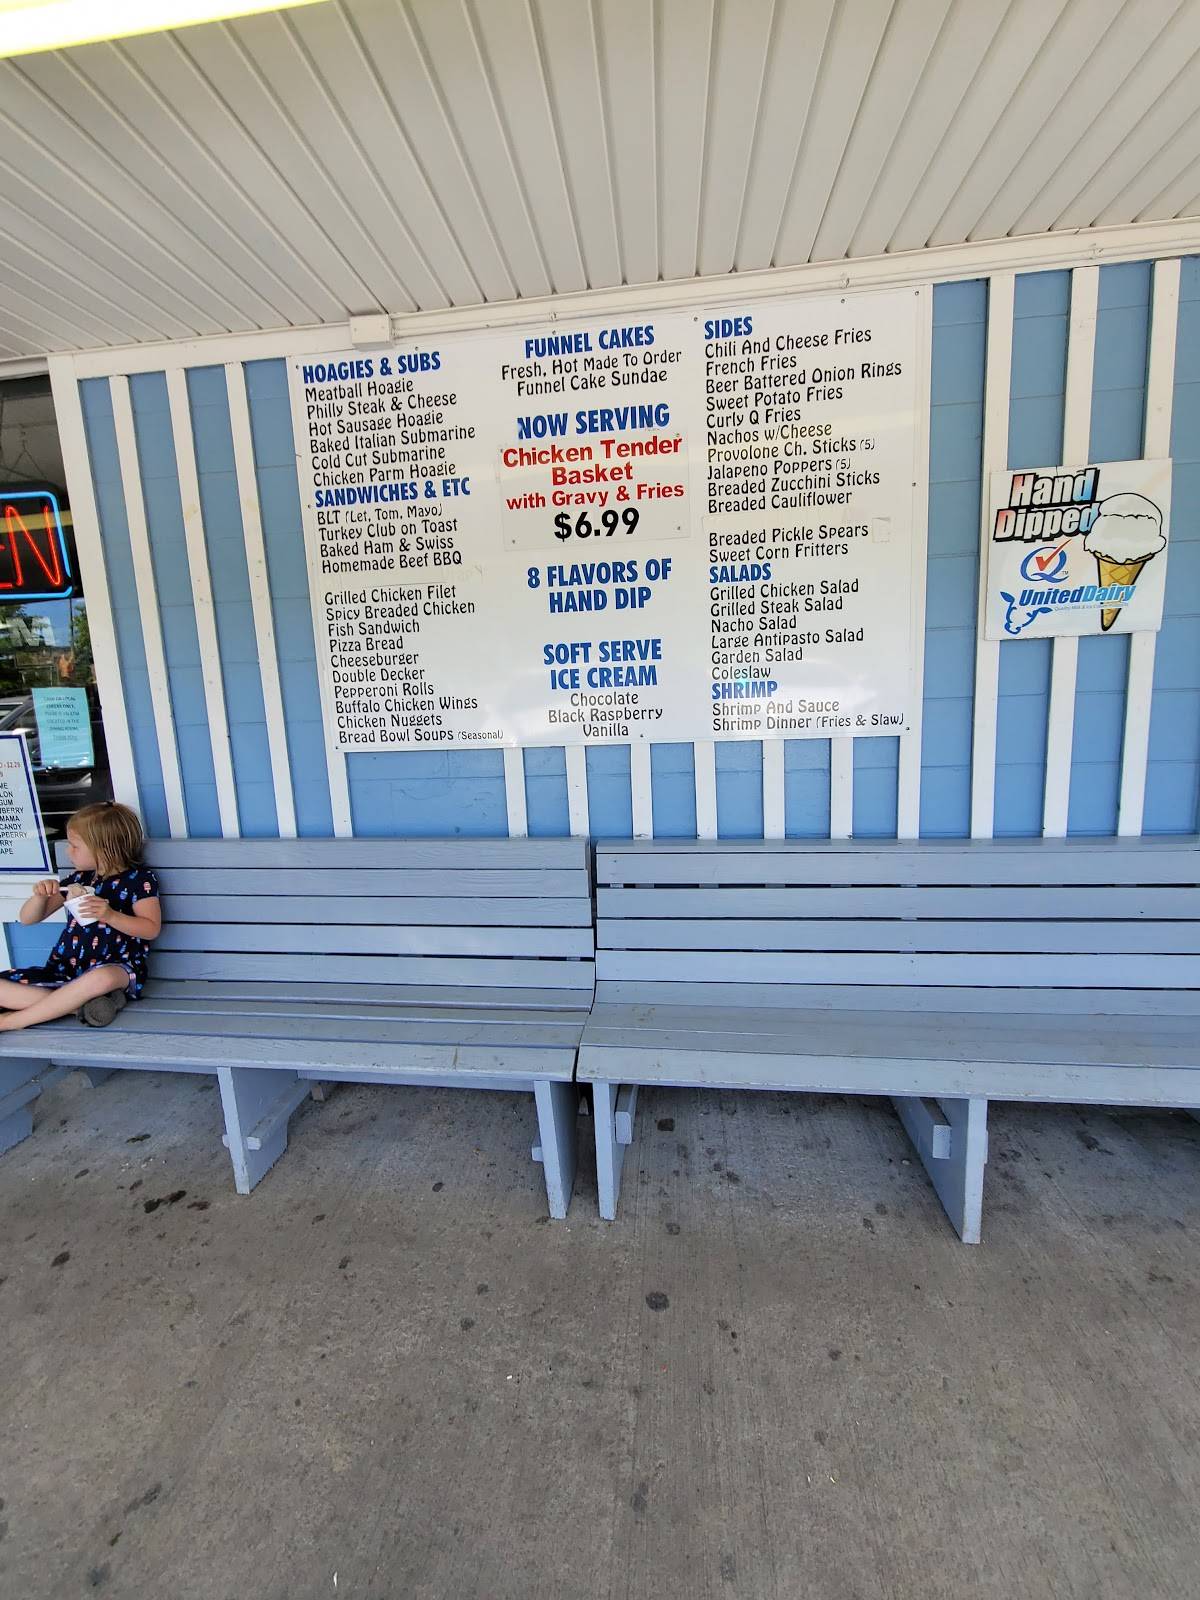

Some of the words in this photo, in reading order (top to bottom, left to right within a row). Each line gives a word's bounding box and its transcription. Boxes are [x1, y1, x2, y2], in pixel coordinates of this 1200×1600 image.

[705, 316, 752, 340] SIDES
[525, 333, 592, 359] FUNNEL
[598, 325, 654, 350] CAKES
[705, 341, 736, 358] Chili
[742, 338, 770, 355] And
[776, 334, 829, 350] Cheese
[834, 328, 872, 345] Fries
[302, 360, 373, 383] HOAGIES
[380, 358, 392, 376] &
[398, 351, 441, 374] SUBS
[501, 362, 546, 380] Fresh,
[552, 359, 578, 375] Hot
[584, 355, 618, 371] Made
[623, 353, 638, 366] To
[643, 350, 682, 365] Order
[706, 359, 754, 376] French
[761, 355, 797, 371] Fries
[517, 377, 565, 396] Funnel
[570, 374, 606, 390] Cake
[611, 368, 668, 386] Sundae
[706, 379, 738, 394] Beer
[744, 370, 806, 390] Battered
[812, 367, 855, 382] Onion
[861, 362, 902, 379] Rings
[305, 382, 362, 402] Meatball
[367, 378, 414, 396] Hoagie
[706, 395, 749, 411] Sweet
[754, 391, 801, 407] Potato
[806, 386, 843, 402] Fries
[307, 404, 343, 419] Philly
[348, 401, 385, 415] Steak
[390, 397, 402, 411] &
[408, 392, 457, 409] Cheese
[309, 422, 332, 436] Hot
[337, 417, 392, 434] Sausage
[397, 410, 443, 428] Hoagie
[517, 413, 568, 439] NOW
[576, 403, 670, 434] SERVING
[706, 412, 744, 428] Curly
[750, 410, 759, 424] Q
[765, 408, 801, 423] Fries
[310, 437, 350, 453] Baked
[355, 434, 396, 449] Italian
[401, 425, 476, 445] Submarine
[707, 430, 759, 445] Nachos
[764, 424, 832, 440] w/Cheese
[312, 455, 341, 470] Cold
[345, 454, 368, 467] Cut
[372, 446, 446, 465] Submarine
[503, 445, 593, 467] Chicken
[600, 436, 682, 459] Tender
[708, 445, 779, 463] Provolone
[784, 442, 807, 456] Ch.
[813, 438, 857, 454] Sticks
[313, 472, 364, 486] Chicken
[369, 468, 404, 482] Parm
[410, 463, 456, 478] Hoagie
[552, 462, 633, 486] Basket
[708, 464, 768, 480] Jalapeno
[774, 459, 833, 475] Poppers
[315, 482, 418, 508] SANDWICHES
[424, 481, 437, 498] &
[442, 477, 471, 496] ETC
[708, 479, 766, 496] Breaded
[771, 475, 831, 492] Zucchini
[836, 470, 880, 487] Sticks
[1009, 468, 1100, 508] Hand
[506, 493, 545, 509] with
[552, 490, 608, 507] Gravy
[616, 485, 630, 501] &
[636, 483, 685, 500] Fries
[708, 496, 766, 513] Breaded
[771, 490, 852, 508] Cauliflower
[318, 510, 340, 525] BLT
[375, 508, 402, 520] Tom,
[407, 504, 442, 518] Mayo)
[554, 508, 639, 542] $6.99
[993, 501, 1101, 542] Dipped
[319, 527, 362, 541] Turkey
[368, 520, 395, 538] Club
[401, 524, 417, 535] on
[422, 518, 458, 533] Toast
[709, 530, 766, 547] Breaded
[772, 527, 814, 542] Pickle
[819, 525, 869, 539] Spears
[320, 542, 359, 558] Baked
[364, 541, 393, 554] Ham
[399, 538, 411, 551] &
[416, 536, 454, 550] Swiss
[709, 549, 751, 563] Sweet
[756, 547, 789, 560] Corn
[795, 543, 848, 558] Fritters
[322, 556, 395, 573] Homemade
[400, 554, 428, 568] Beef
[434, 551, 462, 565] BBQ
[527, 567, 540, 588] 8
[547, 560, 638, 587] FLAVORS
[646, 558, 672, 581] OF
[710, 563, 772, 584] SALADS
[324, 590, 367, 605] Grilled
[371, 587, 422, 603] Chicken
[428, 584, 456, 599] Filet
[550, 590, 607, 613] HAND
[615, 587, 651, 609] DIP
[710, 585, 755, 600] Grilled
[761, 583, 814, 598] Chicken
[820, 578, 859, 594] Salad
[326, 608, 360, 621] Spicy
[365, 604, 418, 619] Breaded
[423, 601, 475, 615] Chicken
[710, 602, 755, 617] Grilled
[761, 599, 799, 614] Steak
[805, 596, 843, 611] Salad
[328, 623, 354, 636] Fish
[358, 620, 420, 635] Sandwich
[711, 618, 754, 632] Nacho
[759, 615, 797, 630] Salad
[329, 639, 361, 652] Pizza
[366, 636, 403, 651] Bread
[712, 634, 749, 649] Large
[754, 631, 820, 647] Antipasto
[825, 628, 864, 643] Salad
[330, 653, 419, 668] Cheeseburger
[544, 642, 592, 665] SOFT
[599, 639, 662, 662] SERVE
[711, 650, 760, 664] Garden
[765, 647, 803, 662] Salad
[332, 669, 376, 683] Double
[381, 668, 425, 681] Decker
[551, 669, 580, 689] ICE
[587, 665, 658, 687] CREAM
[712, 666, 771, 680] Coleslaw
[334, 684, 398, 698] Pepperoni
[402, 682, 434, 696] Rolls
[570, 692, 639, 706] Chocolate
[712, 680, 778, 699] SHRIMP
[336, 700, 380, 713] Buffalo
[385, 698, 435, 712] Chicken
[439, 696, 478, 710] Wings
[337, 716, 386, 728] Chicken
[391, 714, 442, 727] Nuggets
[583, 724, 629, 737] Vanilla
[339, 730, 375, 743] Bread
[380, 729, 410, 742] Bowl
[415, 729, 454, 741] Soups
